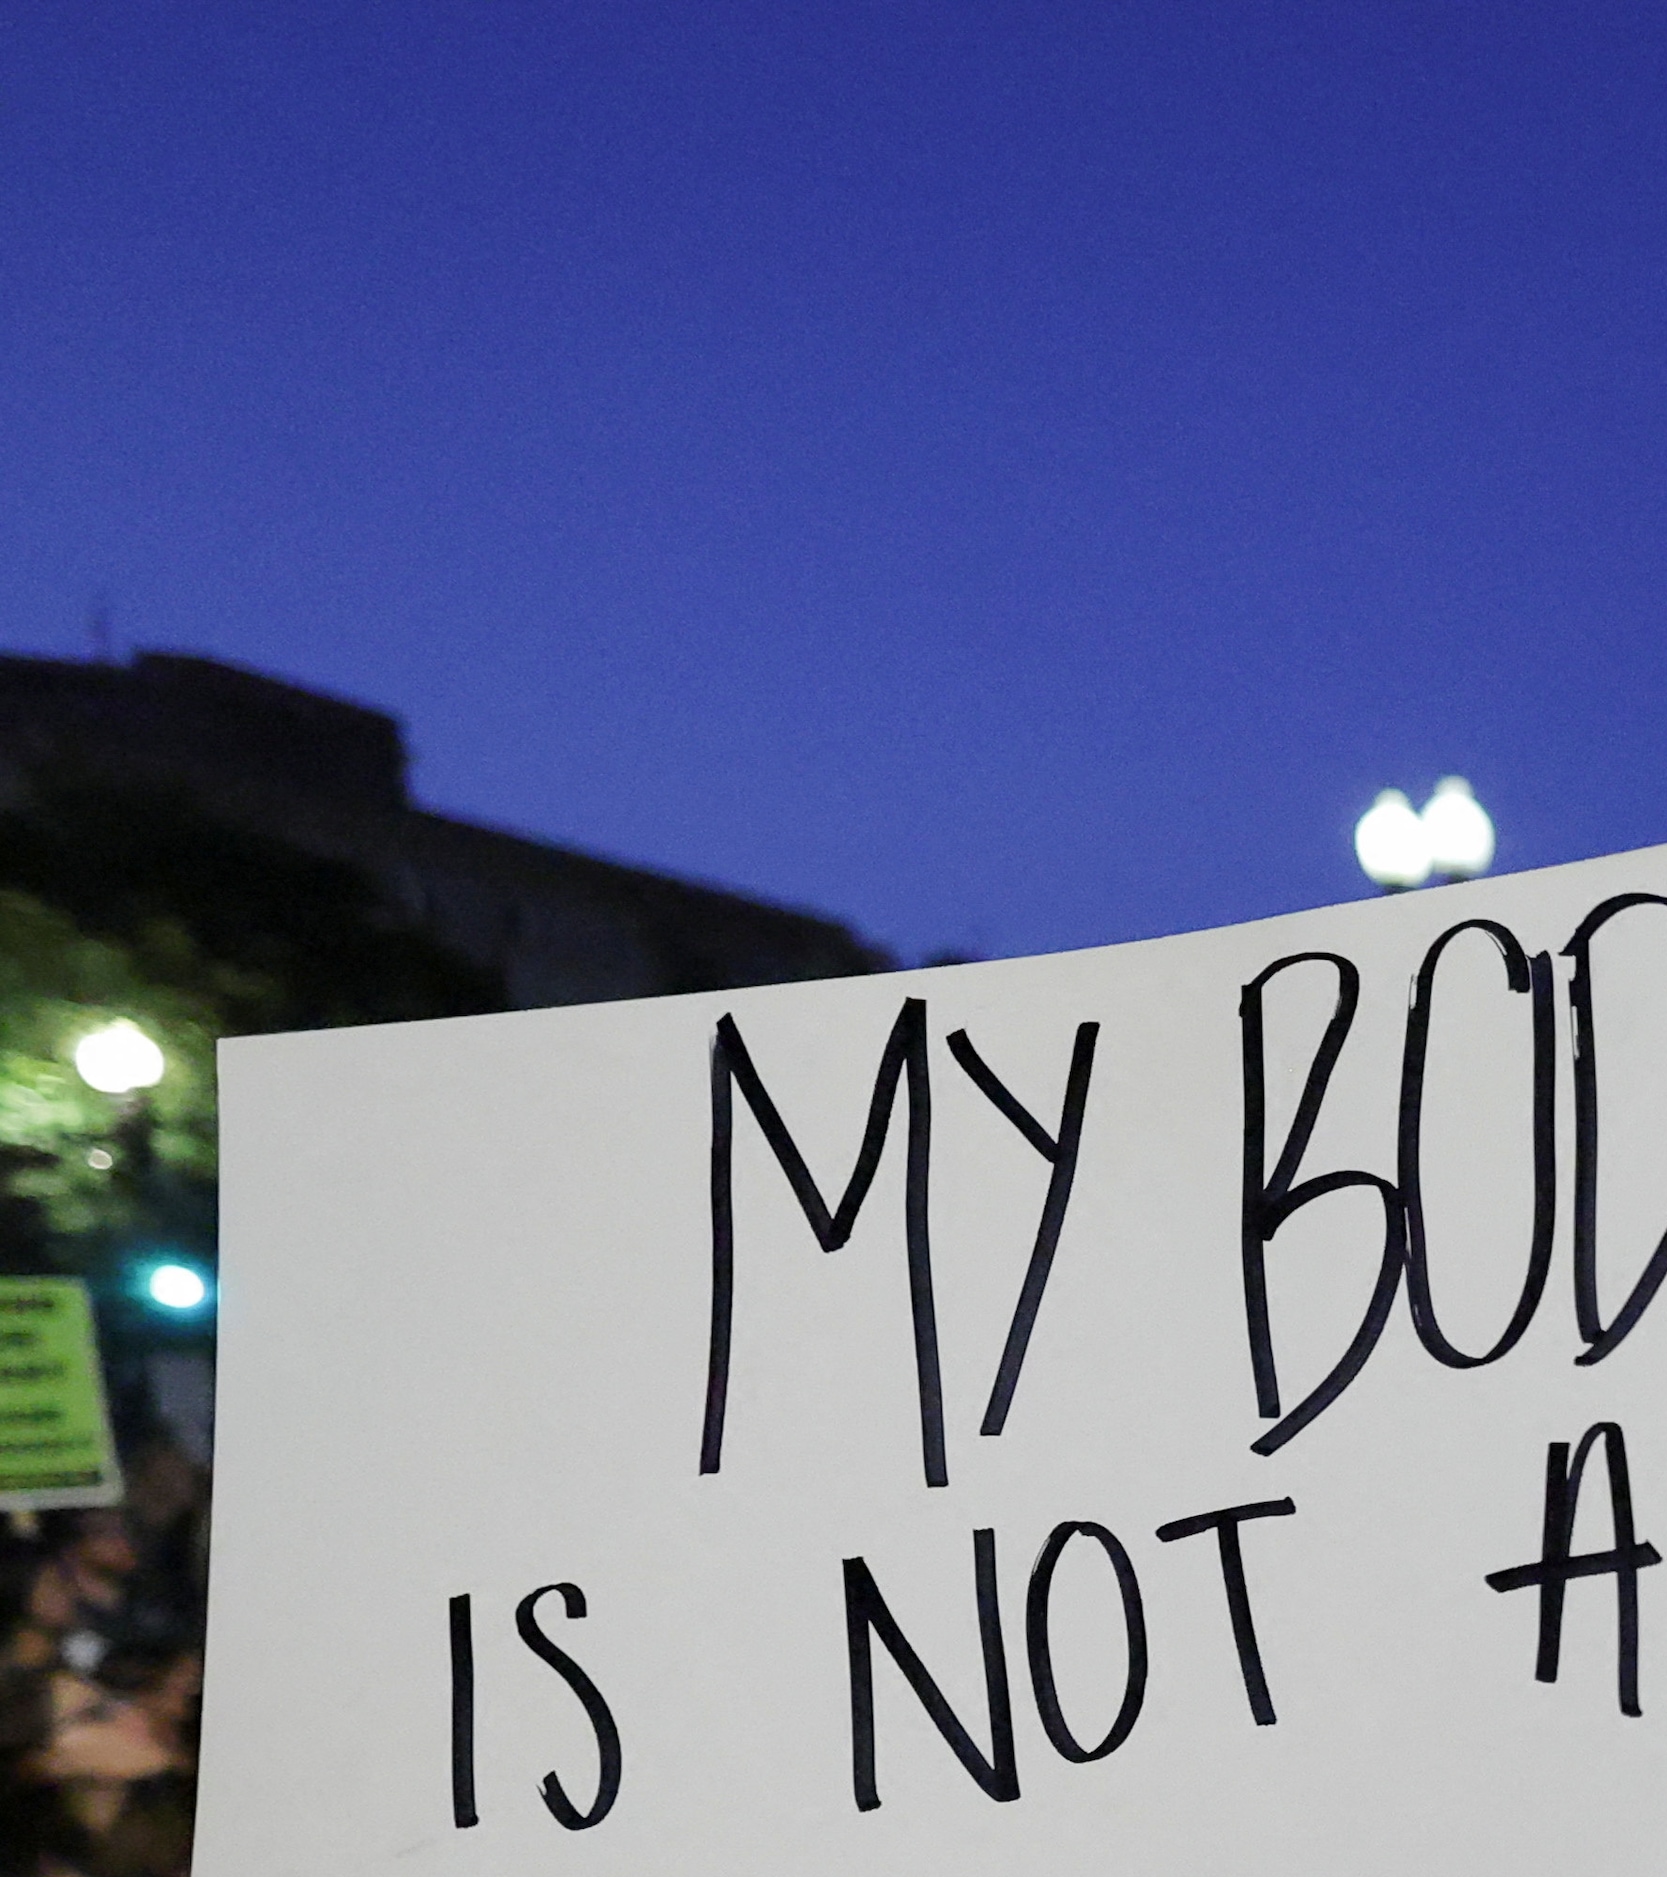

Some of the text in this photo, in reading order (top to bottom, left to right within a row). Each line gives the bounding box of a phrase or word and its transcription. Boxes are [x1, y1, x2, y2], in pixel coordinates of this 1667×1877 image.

[699, 996, 1101, 1488] MY
[449, 1421, 1663, 1831] IS NOT A
